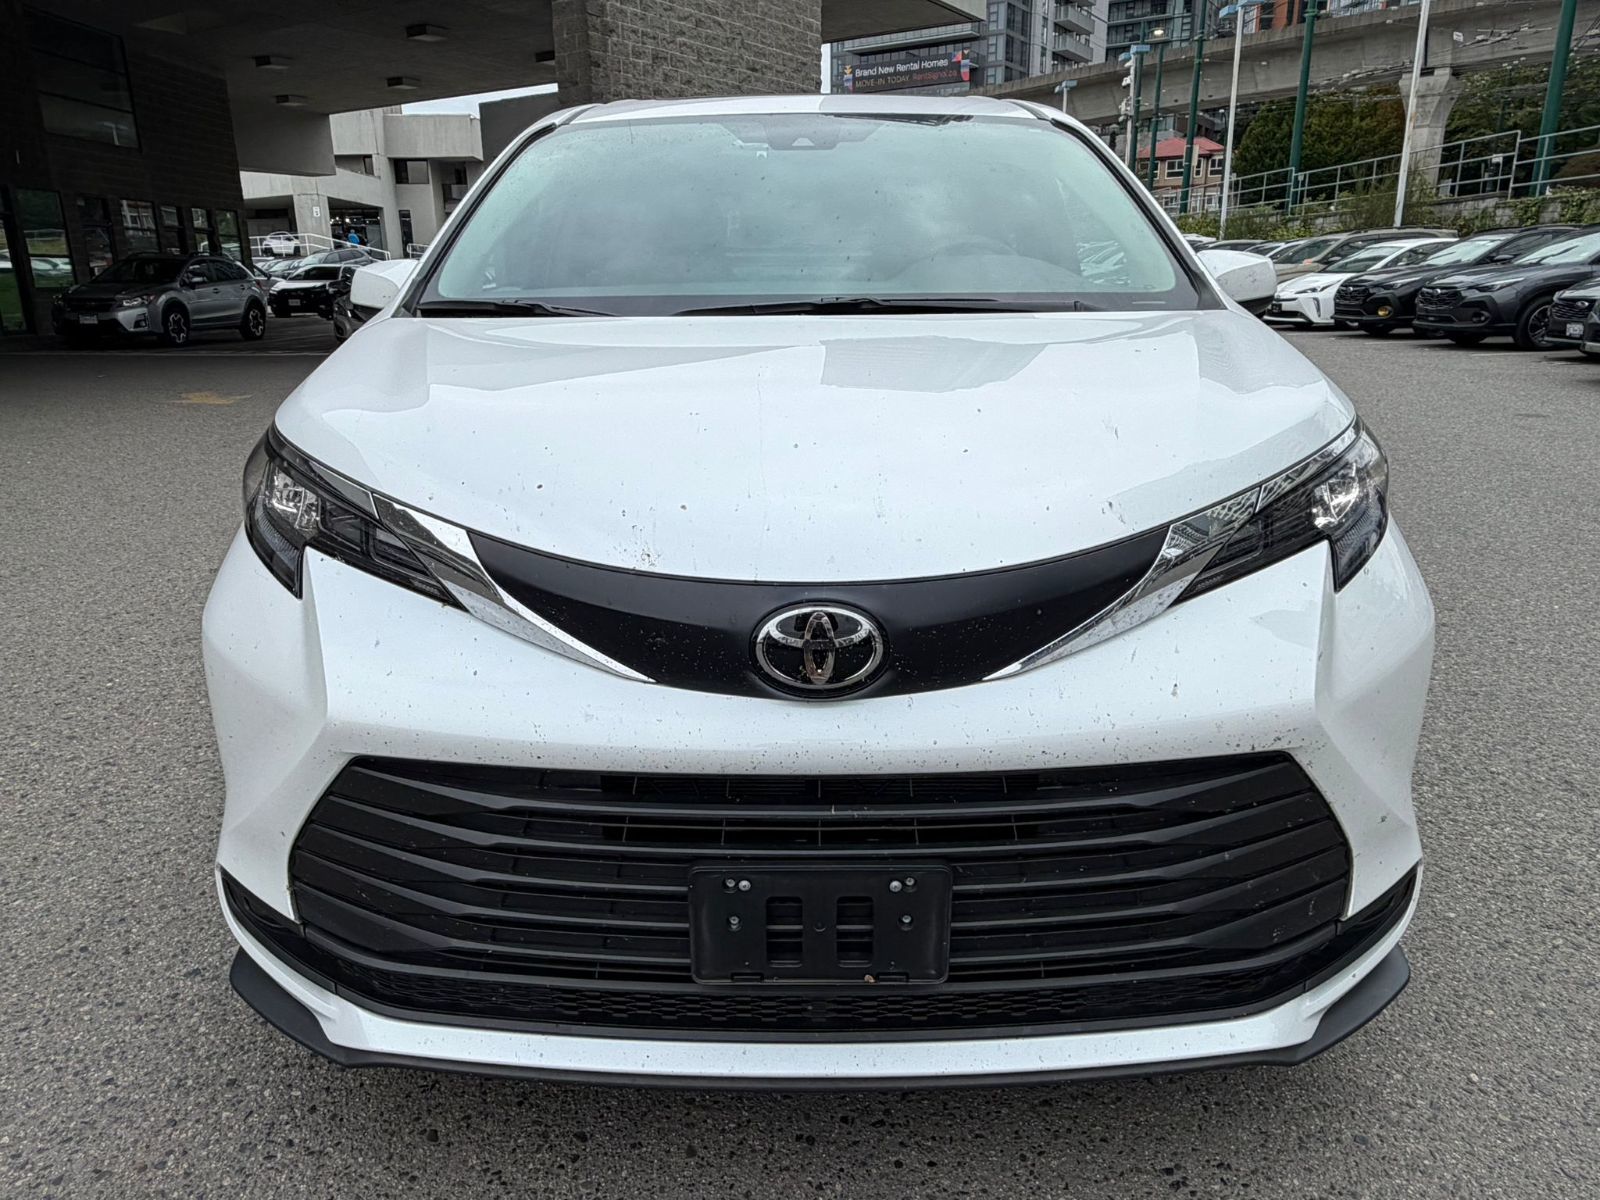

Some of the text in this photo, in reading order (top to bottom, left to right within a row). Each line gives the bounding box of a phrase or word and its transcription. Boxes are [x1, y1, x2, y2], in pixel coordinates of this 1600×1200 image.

[855, 59, 948, 77] Brand New Rental Homes
[887, 74, 910, 84] TODAY
